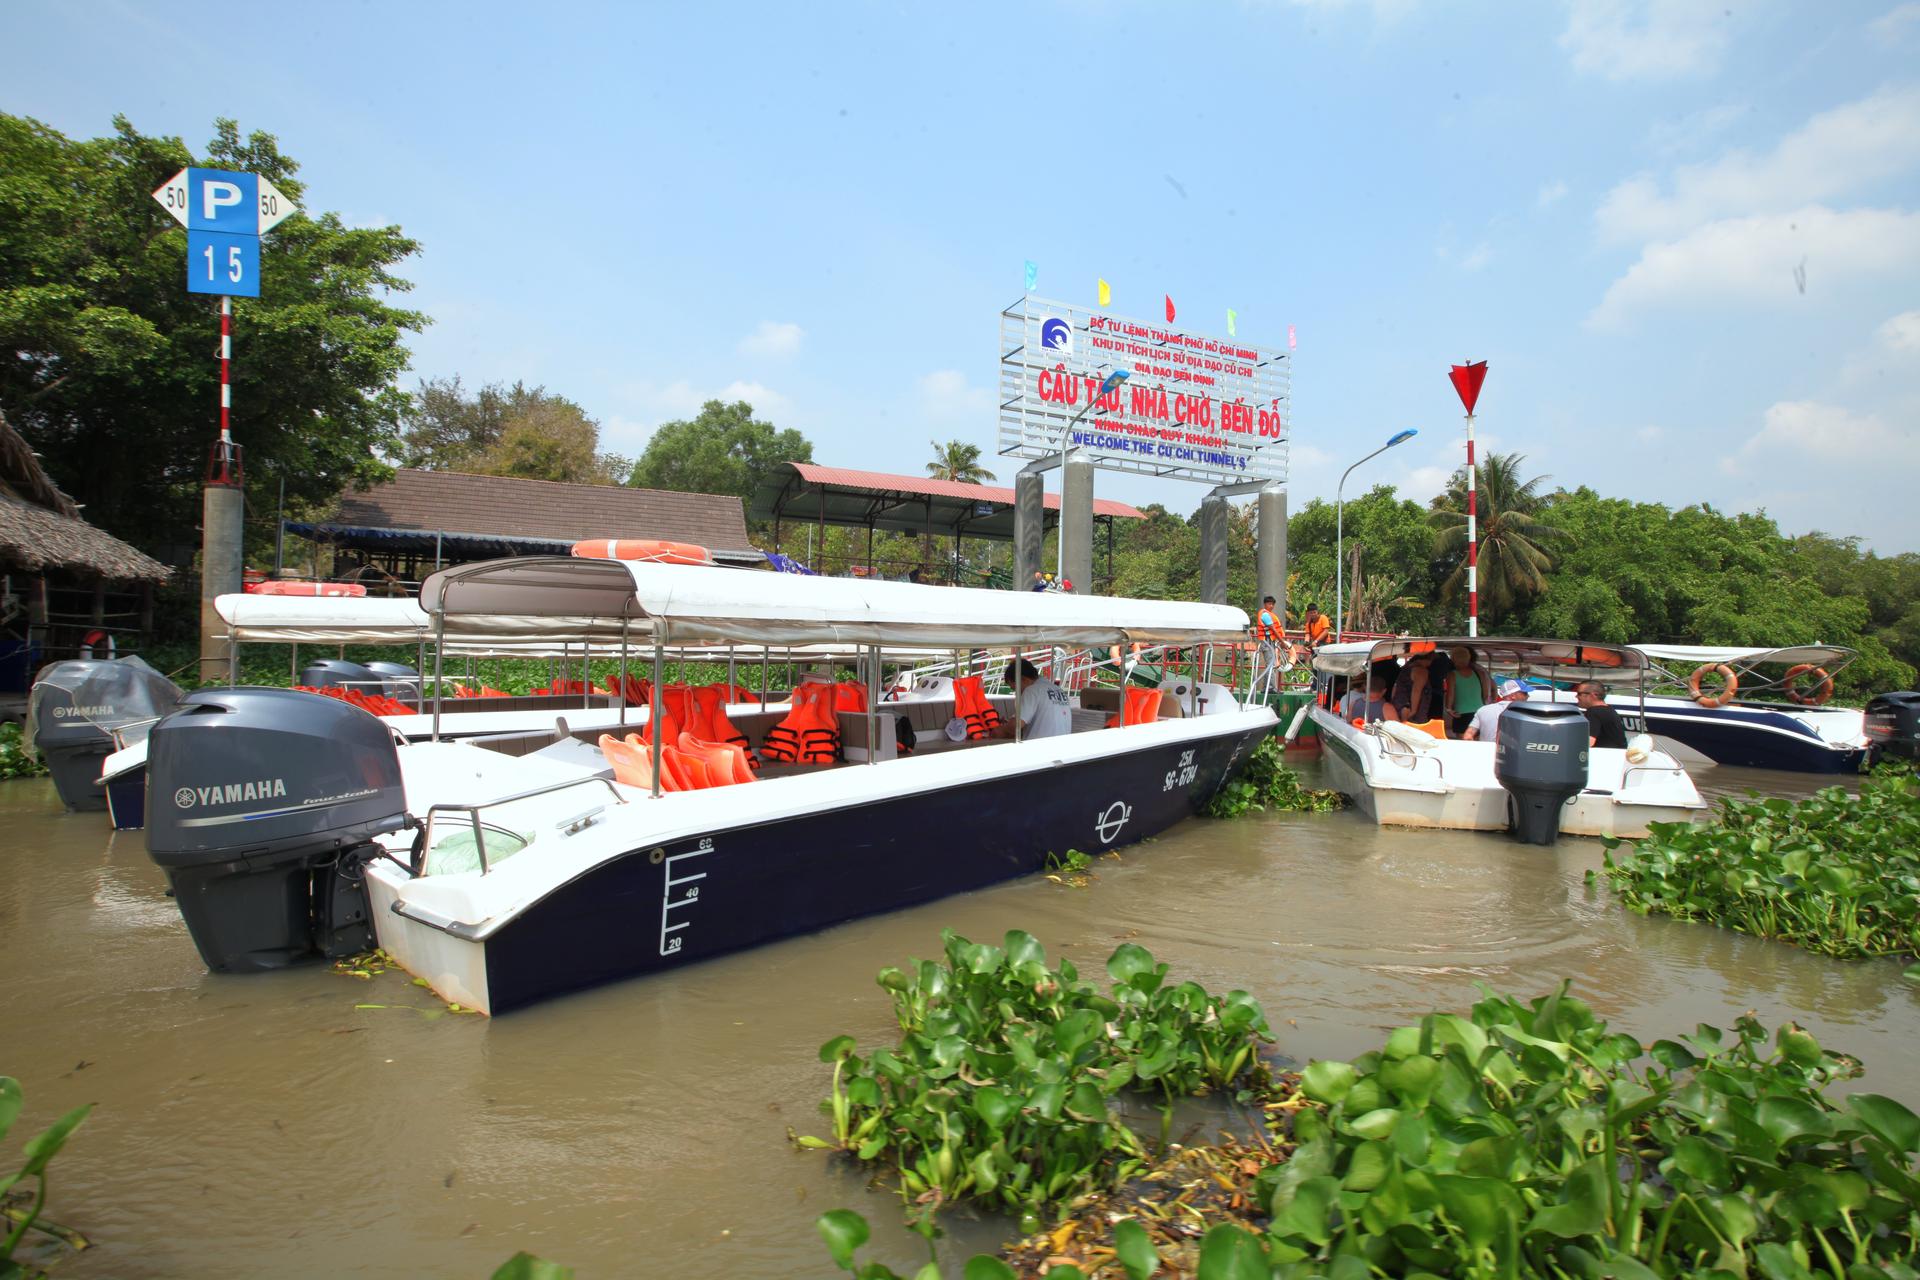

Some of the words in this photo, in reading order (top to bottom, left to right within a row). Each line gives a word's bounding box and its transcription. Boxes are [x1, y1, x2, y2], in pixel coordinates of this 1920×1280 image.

[167, 187, 185, 209] 50
[203, 180, 243, 220] P
[261, 195, 278, 217] 50
[1093, 336, 1114, 350] KHU
[1115, 344, 1125, 353] DI
[1127, 342, 1149, 356] TÍCH
[1150, 348, 1171, 362] LỊCH
[1238, 366, 1253, 378] CHI
[1221, 397, 1253, 434] BẾN
[1072, 431, 1130, 451] WELCOME
[1132, 440, 1153, 454] THE
[1175, 447, 1194, 460] CHI
[66, 705, 114, 717] YAMAHA
[1526, 742, 1560, 752] 200
[198, 779, 286, 806] YAMAHA
[699, 838, 713, 850] 60
[686, 887, 699, 898] 40
[668, 937, 682, 950] 20
